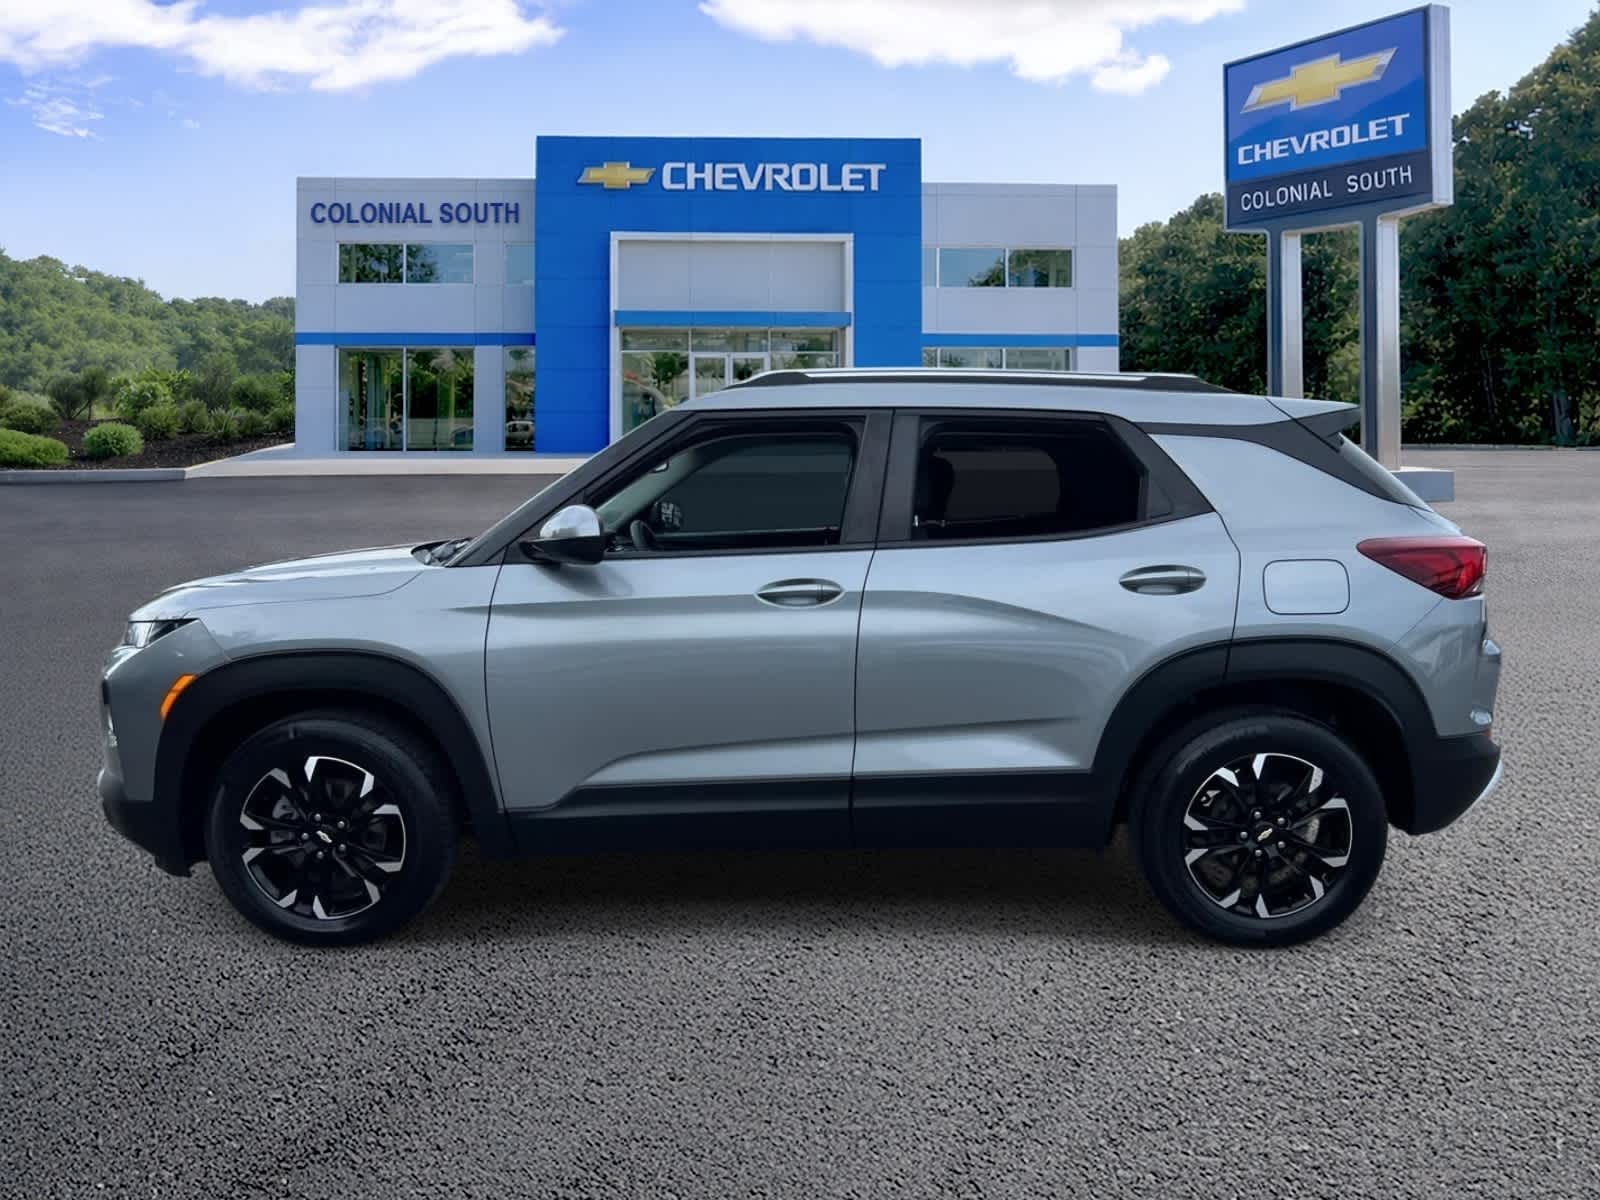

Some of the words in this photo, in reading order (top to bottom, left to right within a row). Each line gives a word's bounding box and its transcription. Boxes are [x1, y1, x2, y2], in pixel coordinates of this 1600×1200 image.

[1238, 113, 1410, 165] CHEVROLET
[661, 162, 887, 192] CHEVROLET
[1240, 180, 1333, 212] COLONIAL
[1347, 165, 1413, 193] SOUTH
[310, 202, 432, 224] COLONIAL
[439, 202, 520, 224] SOUTH
